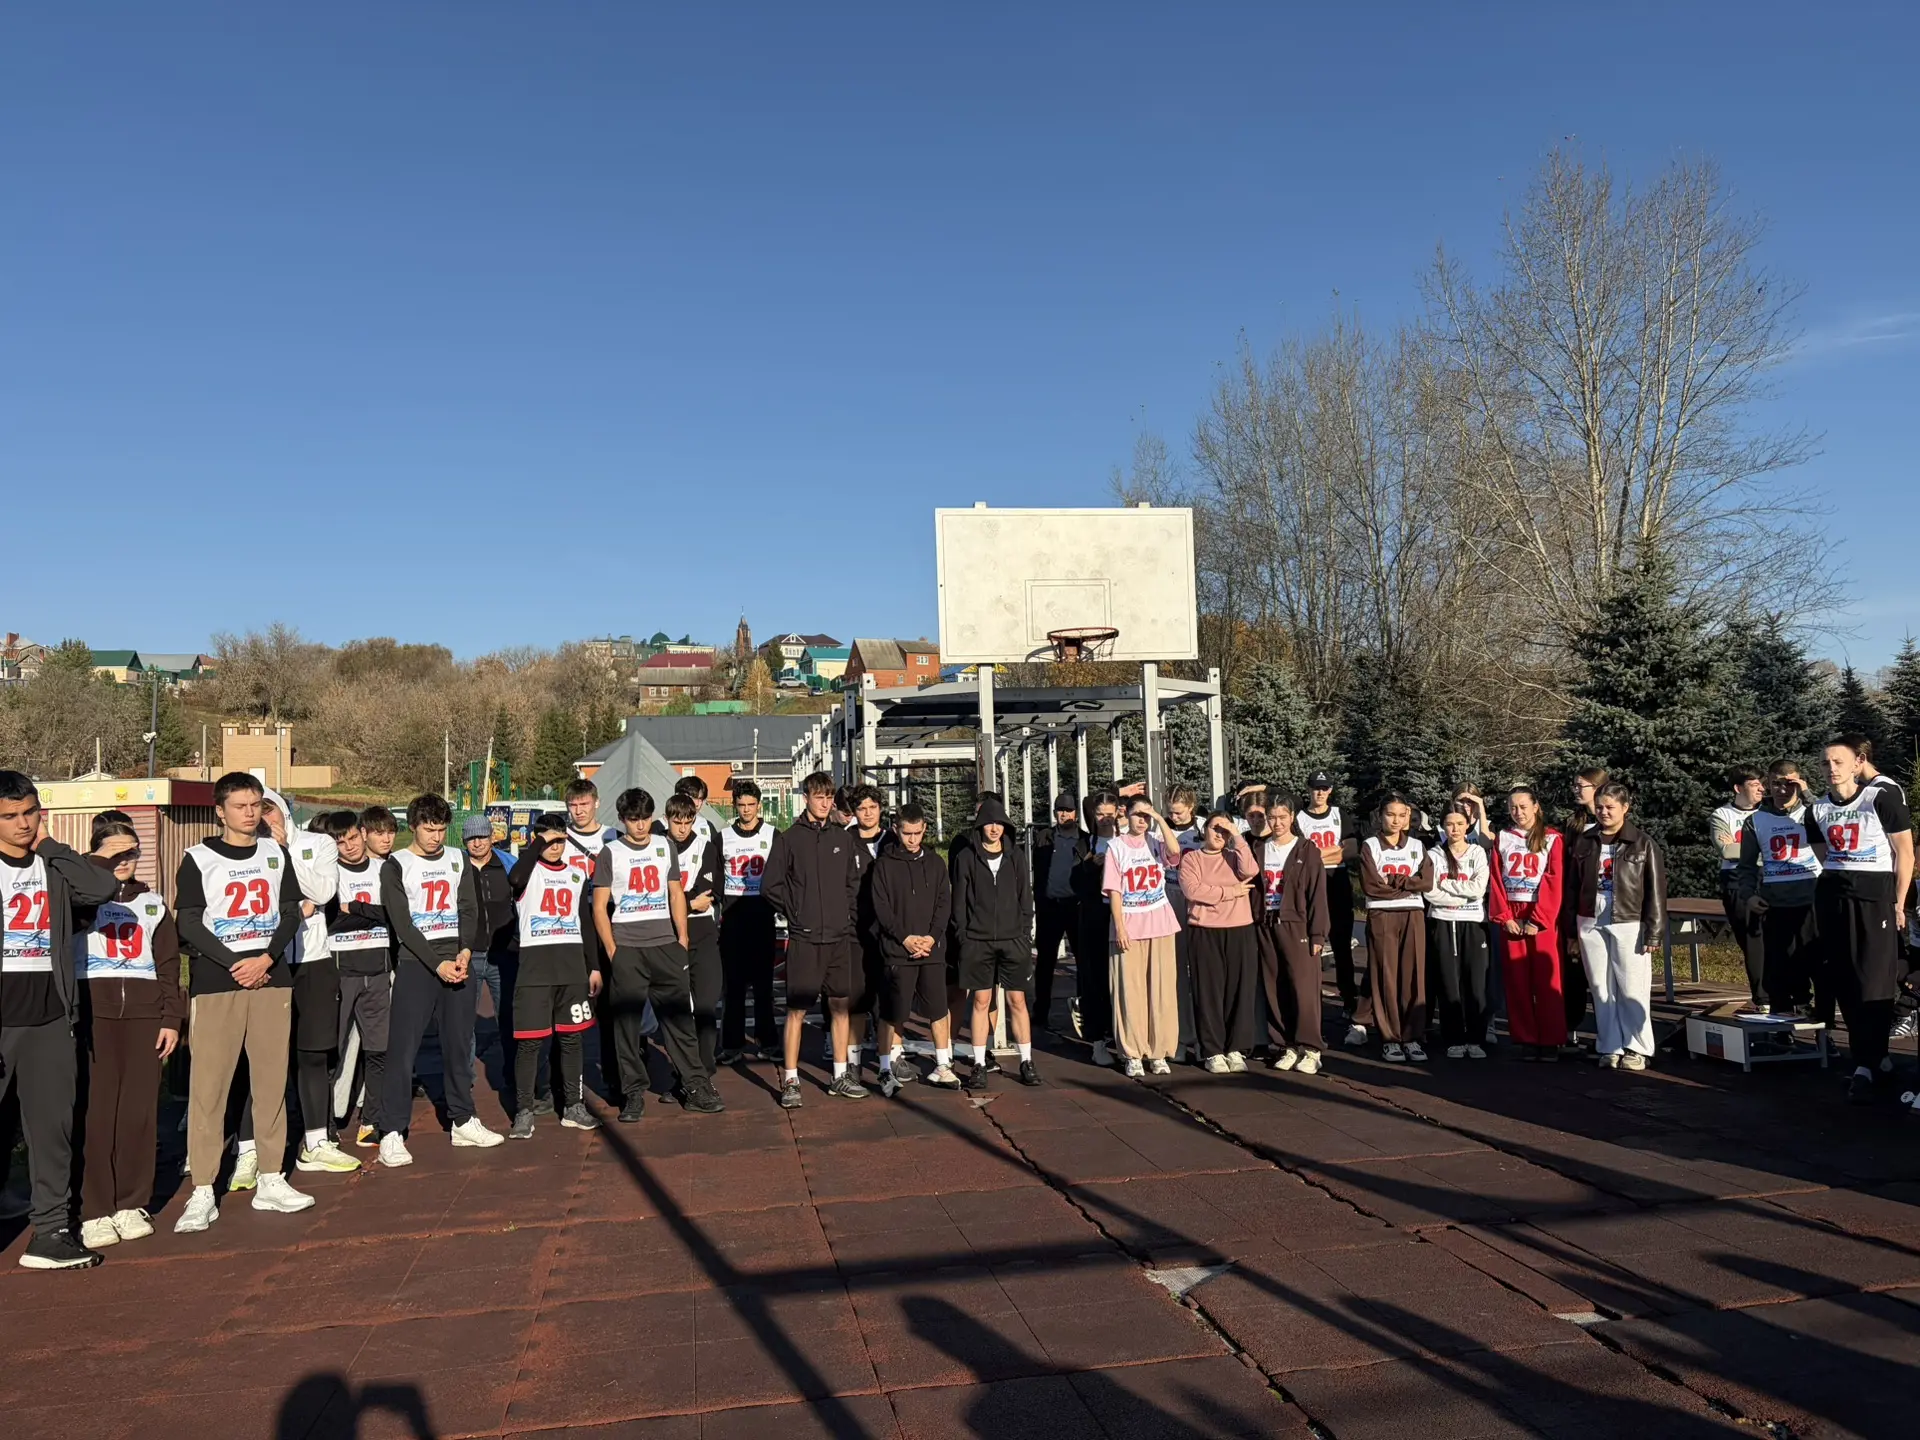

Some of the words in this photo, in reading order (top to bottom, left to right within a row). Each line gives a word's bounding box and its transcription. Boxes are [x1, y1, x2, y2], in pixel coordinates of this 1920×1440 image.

[1827, 810, 1859, 823] АРЧА
[1769, 833, 1800, 861] 97
[1827, 823, 1860, 852] 87
[628, 865, 660, 893] 48
[729, 855, 765, 877] 129
[1124, 864, 1162, 893] 125
[1508, 852, 1539, 878] 29
[225, 878, 270, 918] 23
[421, 880, 451, 911] 72
[541, 888, 572, 916] 49
[8, 890, 51, 930] 22
[99, 922, 144, 959] 19
[570, 1001, 592, 1024] 99
